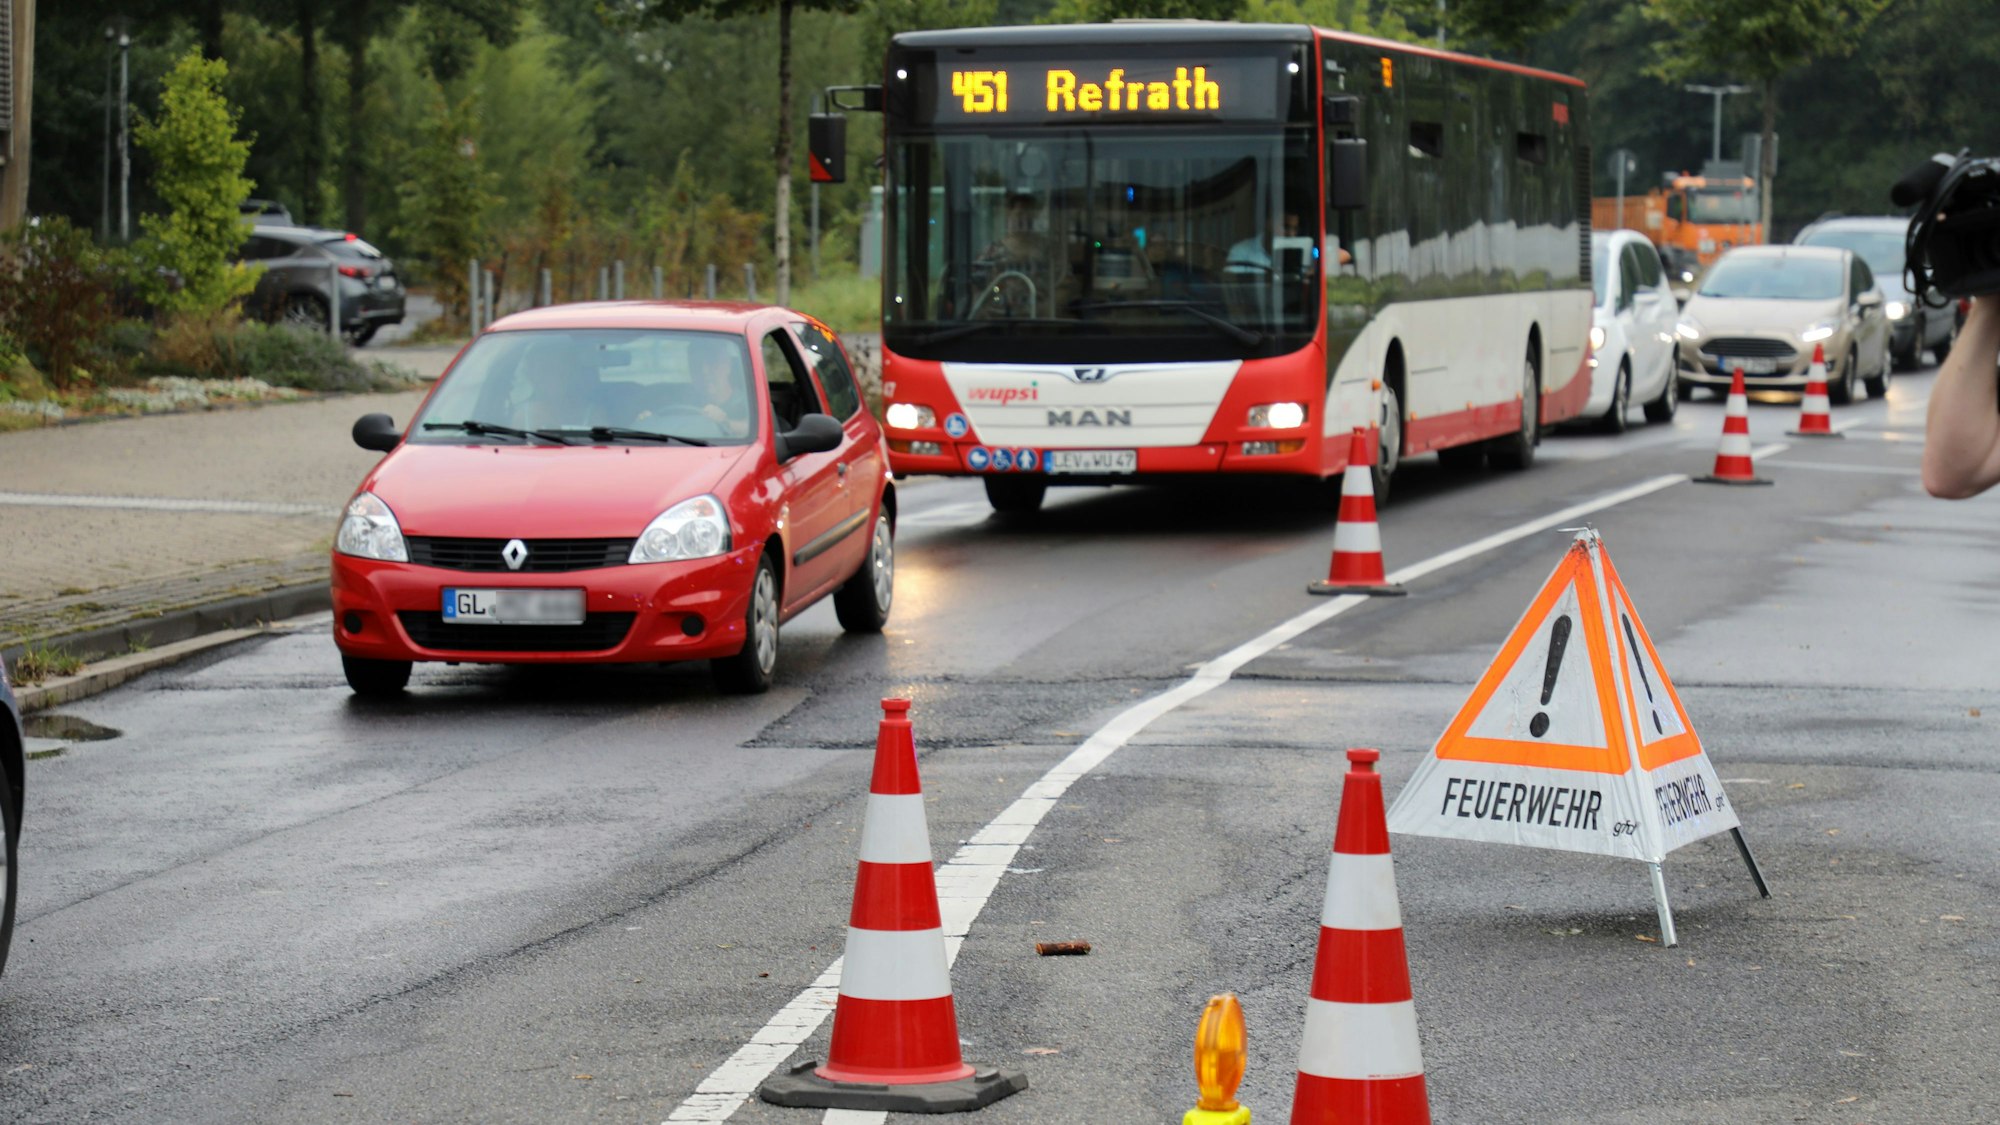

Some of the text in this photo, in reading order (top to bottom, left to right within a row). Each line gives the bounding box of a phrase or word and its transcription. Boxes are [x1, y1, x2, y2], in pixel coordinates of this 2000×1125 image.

[952, 66, 1220, 112] 451 Refrath
[968, 380, 1039, 405] wupsi
[1048, 410, 1131, 426] MAN
[1054, 452, 1082, 468] LEV
[457, 593, 486, 615] GL
[1441, 777, 1603, 830] FEUERWEHR
[1654, 773, 1712, 826] FEUERWEHR
